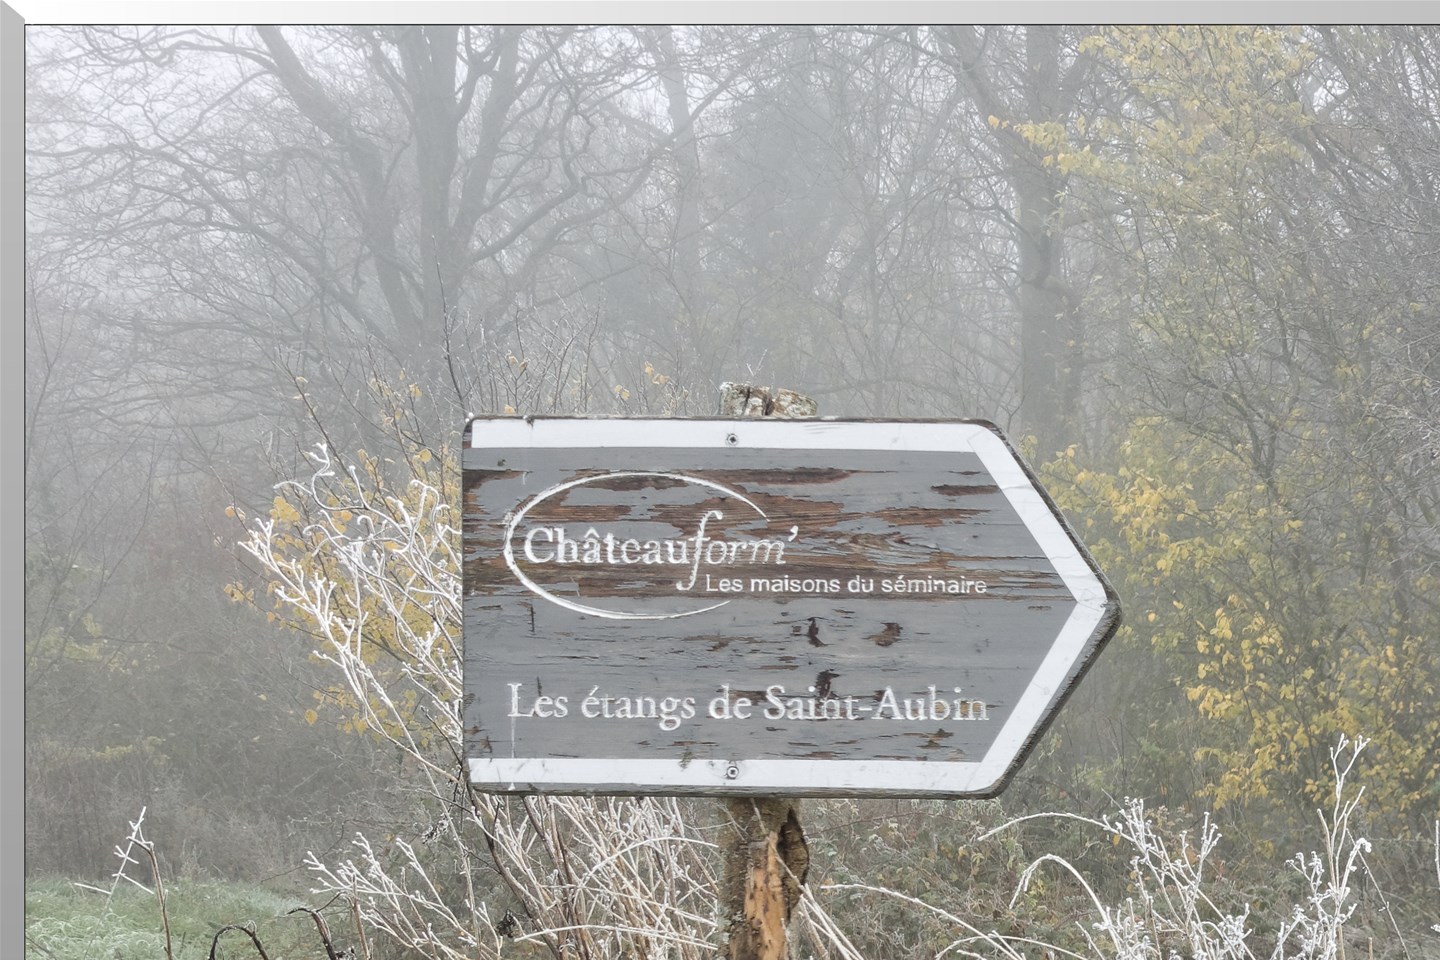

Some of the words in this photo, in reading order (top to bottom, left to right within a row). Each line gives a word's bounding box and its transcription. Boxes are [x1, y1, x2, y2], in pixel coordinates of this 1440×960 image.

[706, 574, 743, 592] Les
[750, 575, 840, 592] maisons
[847, 575, 874, 593] du
[881, 575, 987, 594] séminaire
[507, 683, 568, 718] Les
[581, 685, 696, 731] étangs
[709, 683, 752, 719] de
[763, 685, 990, 720] Saint-Aubin
